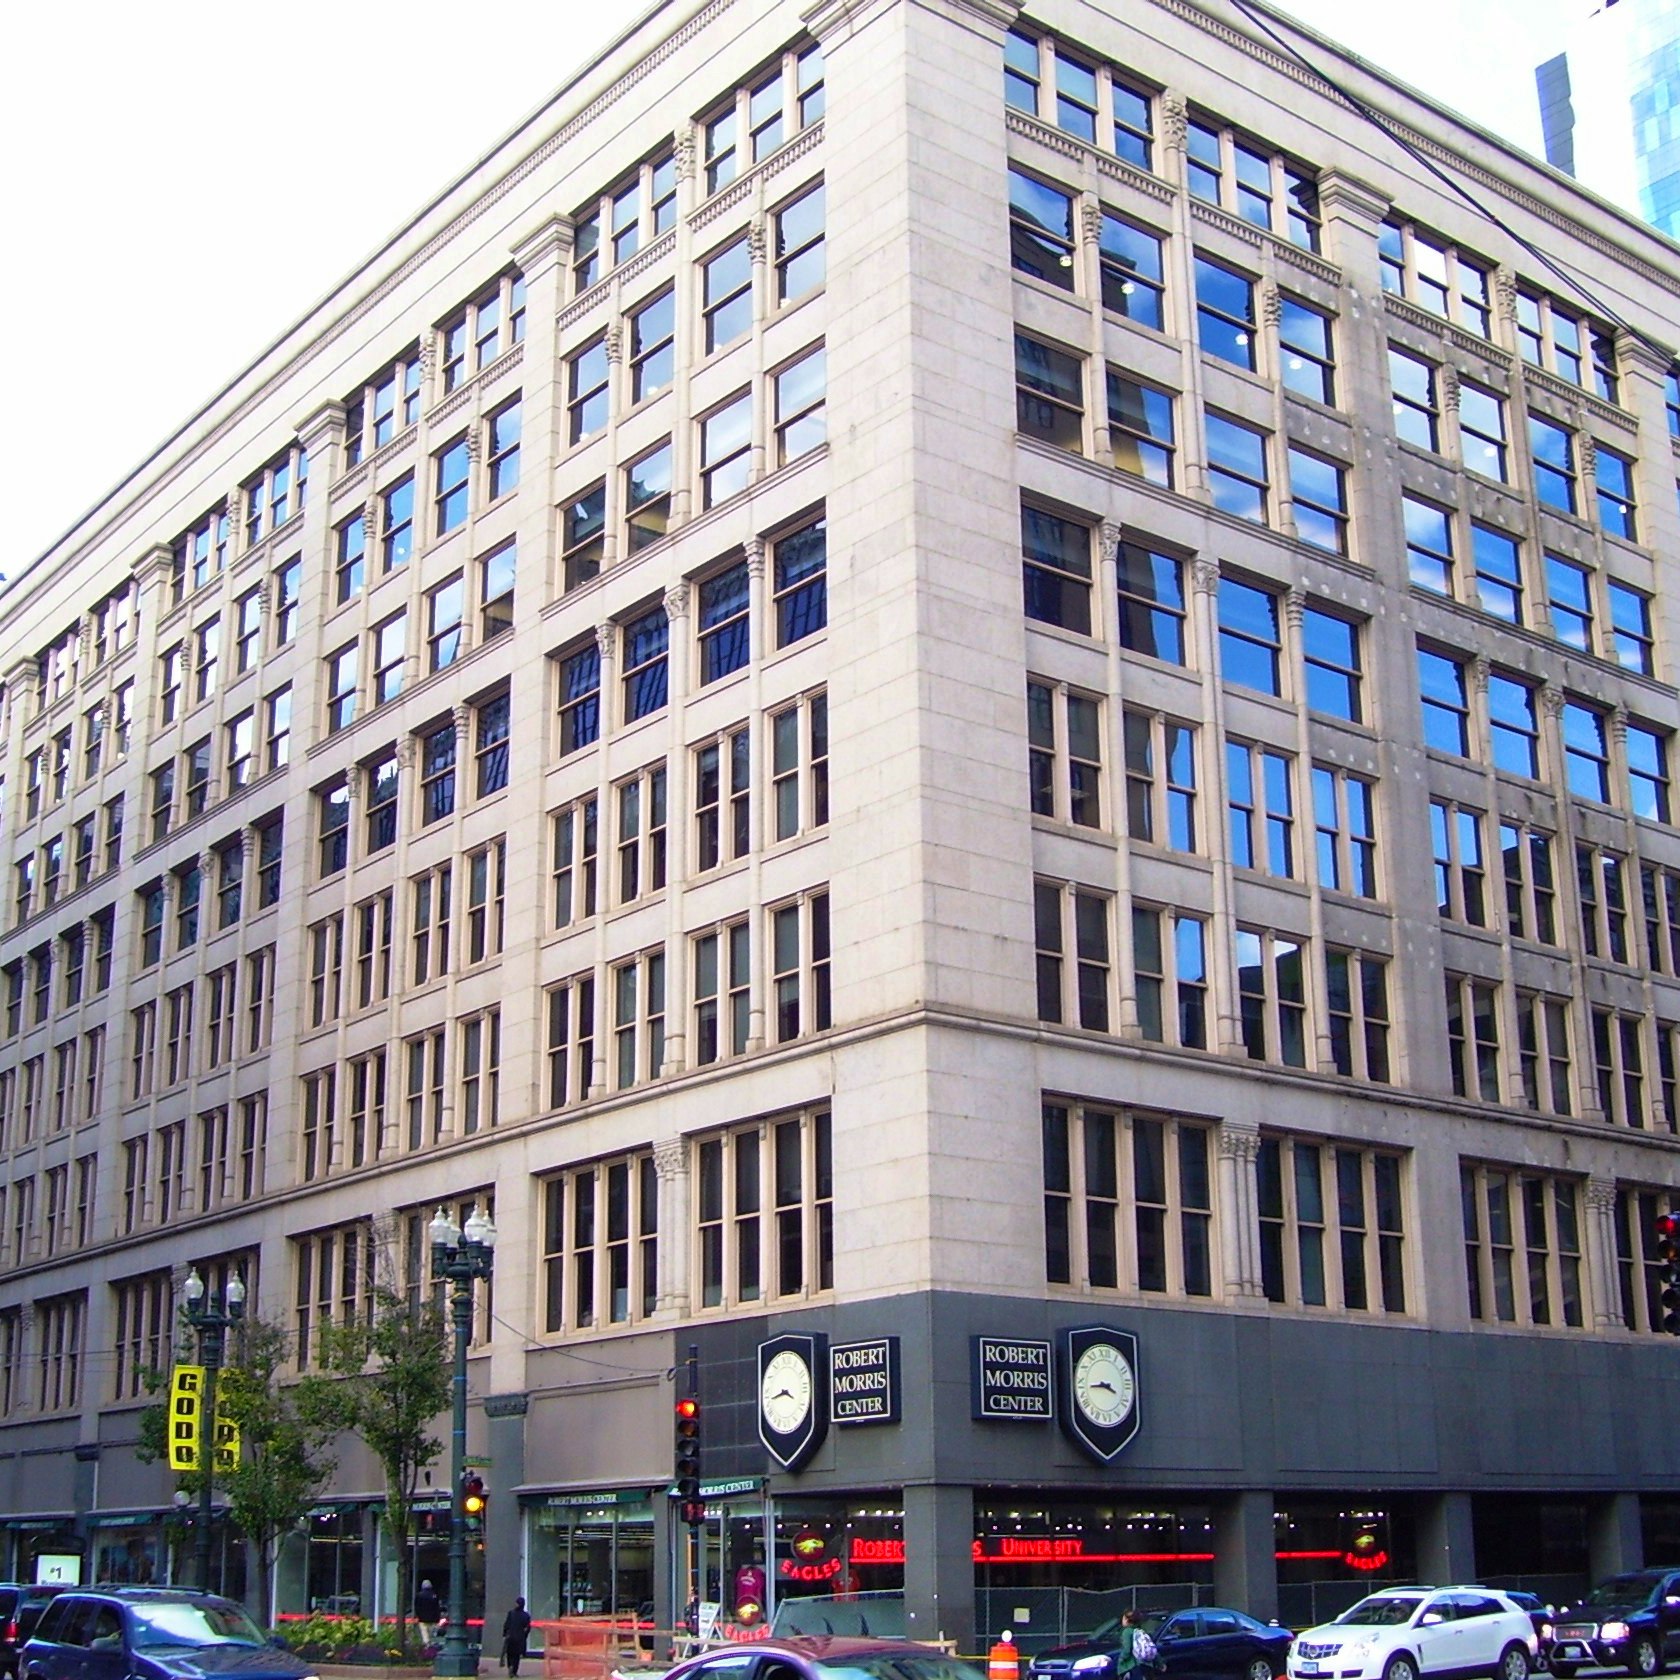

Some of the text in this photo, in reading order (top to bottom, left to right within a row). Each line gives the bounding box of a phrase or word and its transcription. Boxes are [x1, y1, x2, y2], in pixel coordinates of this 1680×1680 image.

[834, 1347, 886, 1369] ROBERT
[985, 1345, 1046, 1365] ROBERT
[834, 1371, 887, 1394] MORRIS
[985, 1369, 1048, 1390] MORRIS
[837, 1396, 883, 1416] CENTER
[989, 1394, 1044, 1412] CENTER
[725, 1480, 755, 1493] CENTER
[780, 1556, 842, 1581] EAGLES
